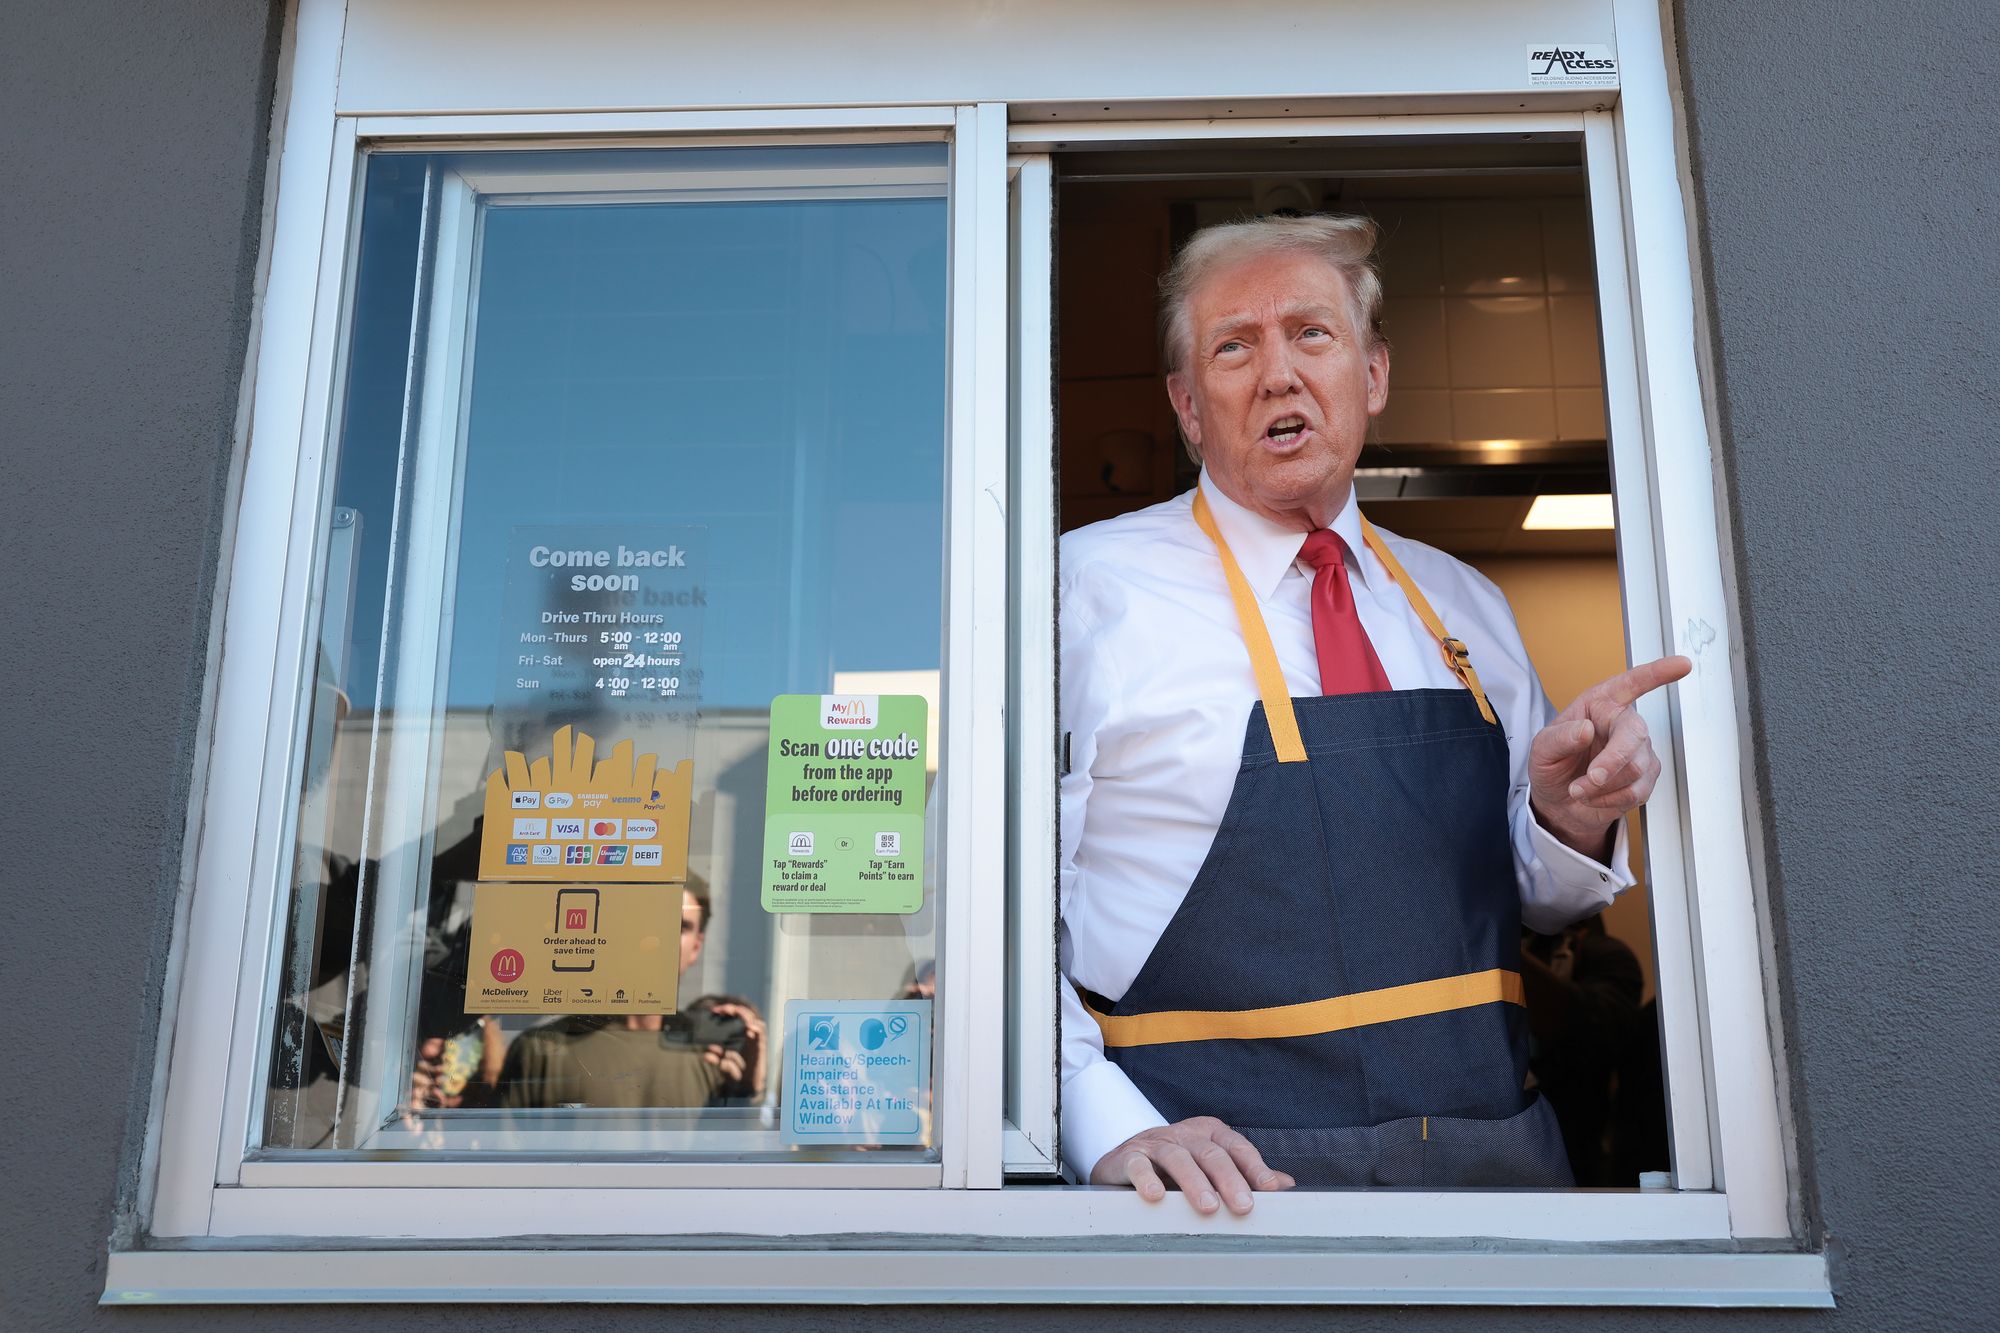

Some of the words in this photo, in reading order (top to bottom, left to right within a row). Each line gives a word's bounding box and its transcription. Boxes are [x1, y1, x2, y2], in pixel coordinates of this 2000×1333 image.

[1531, 47, 1585, 63] READY
[529, 546, 610, 567] Come
[617, 545, 686, 567] back
[571, 574, 639, 592] soon
[542, 611, 579, 624] Drive
[583, 611, 616, 624] Thru
[620, 611, 664, 624] Hours
[600, 632, 632, 644] 5:00
[643, 632, 682, 644] 12:00
[663, 643, 677, 651] am
[593, 657, 622, 668] open
[623, 654, 646, 668] 24
[647, 656, 681, 666] hours
[516, 678, 539, 689] Sun
[641, 678, 679, 689] 12:00
[831, 704, 847, 714] My
[827, 716, 871, 725] Rewards
[780, 738, 819, 757] Scan
[825, 737, 865, 760] one
[867, 732, 919, 760] code
[803, 764, 836, 780] from
[840, 764, 863, 780] the
[866, 768, 893, 784] app
[792, 786, 838, 802] before
[841, 786, 902, 806] ordering
[522, 796, 537, 805] Pay
[557, 797, 569, 805] Pay
[643, 803, 666, 811] PayPal
[583, 800, 602, 809] pay
[557, 825, 580, 833] VISA
[513, 854, 527, 862] EX
[635, 851, 660, 860] DEBIT
[773, 860, 786, 869] Tap
[869, 860, 882, 869] Tap
[782, 871, 789, 880] to
[791, 871, 812, 880] claim
[888, 872, 896, 880] to
[772, 883, 799, 891] reward
[810, 883, 826, 891] deal
[543, 937, 568, 945] Order
[569, 937, 596, 945] ahead
[575, 947, 595, 955] time
[482, 988, 529, 997] McDelivery
[543, 996, 562, 1004] Eats
[800, 1068, 858, 1083] Impaired
[800, 1083, 875, 1095] Assistance
[800, 1097, 862, 1110] Available
[866, 1098, 881, 1110] At
[885, 1097, 914, 1110] This
[799, 1113, 854, 1124] Window
